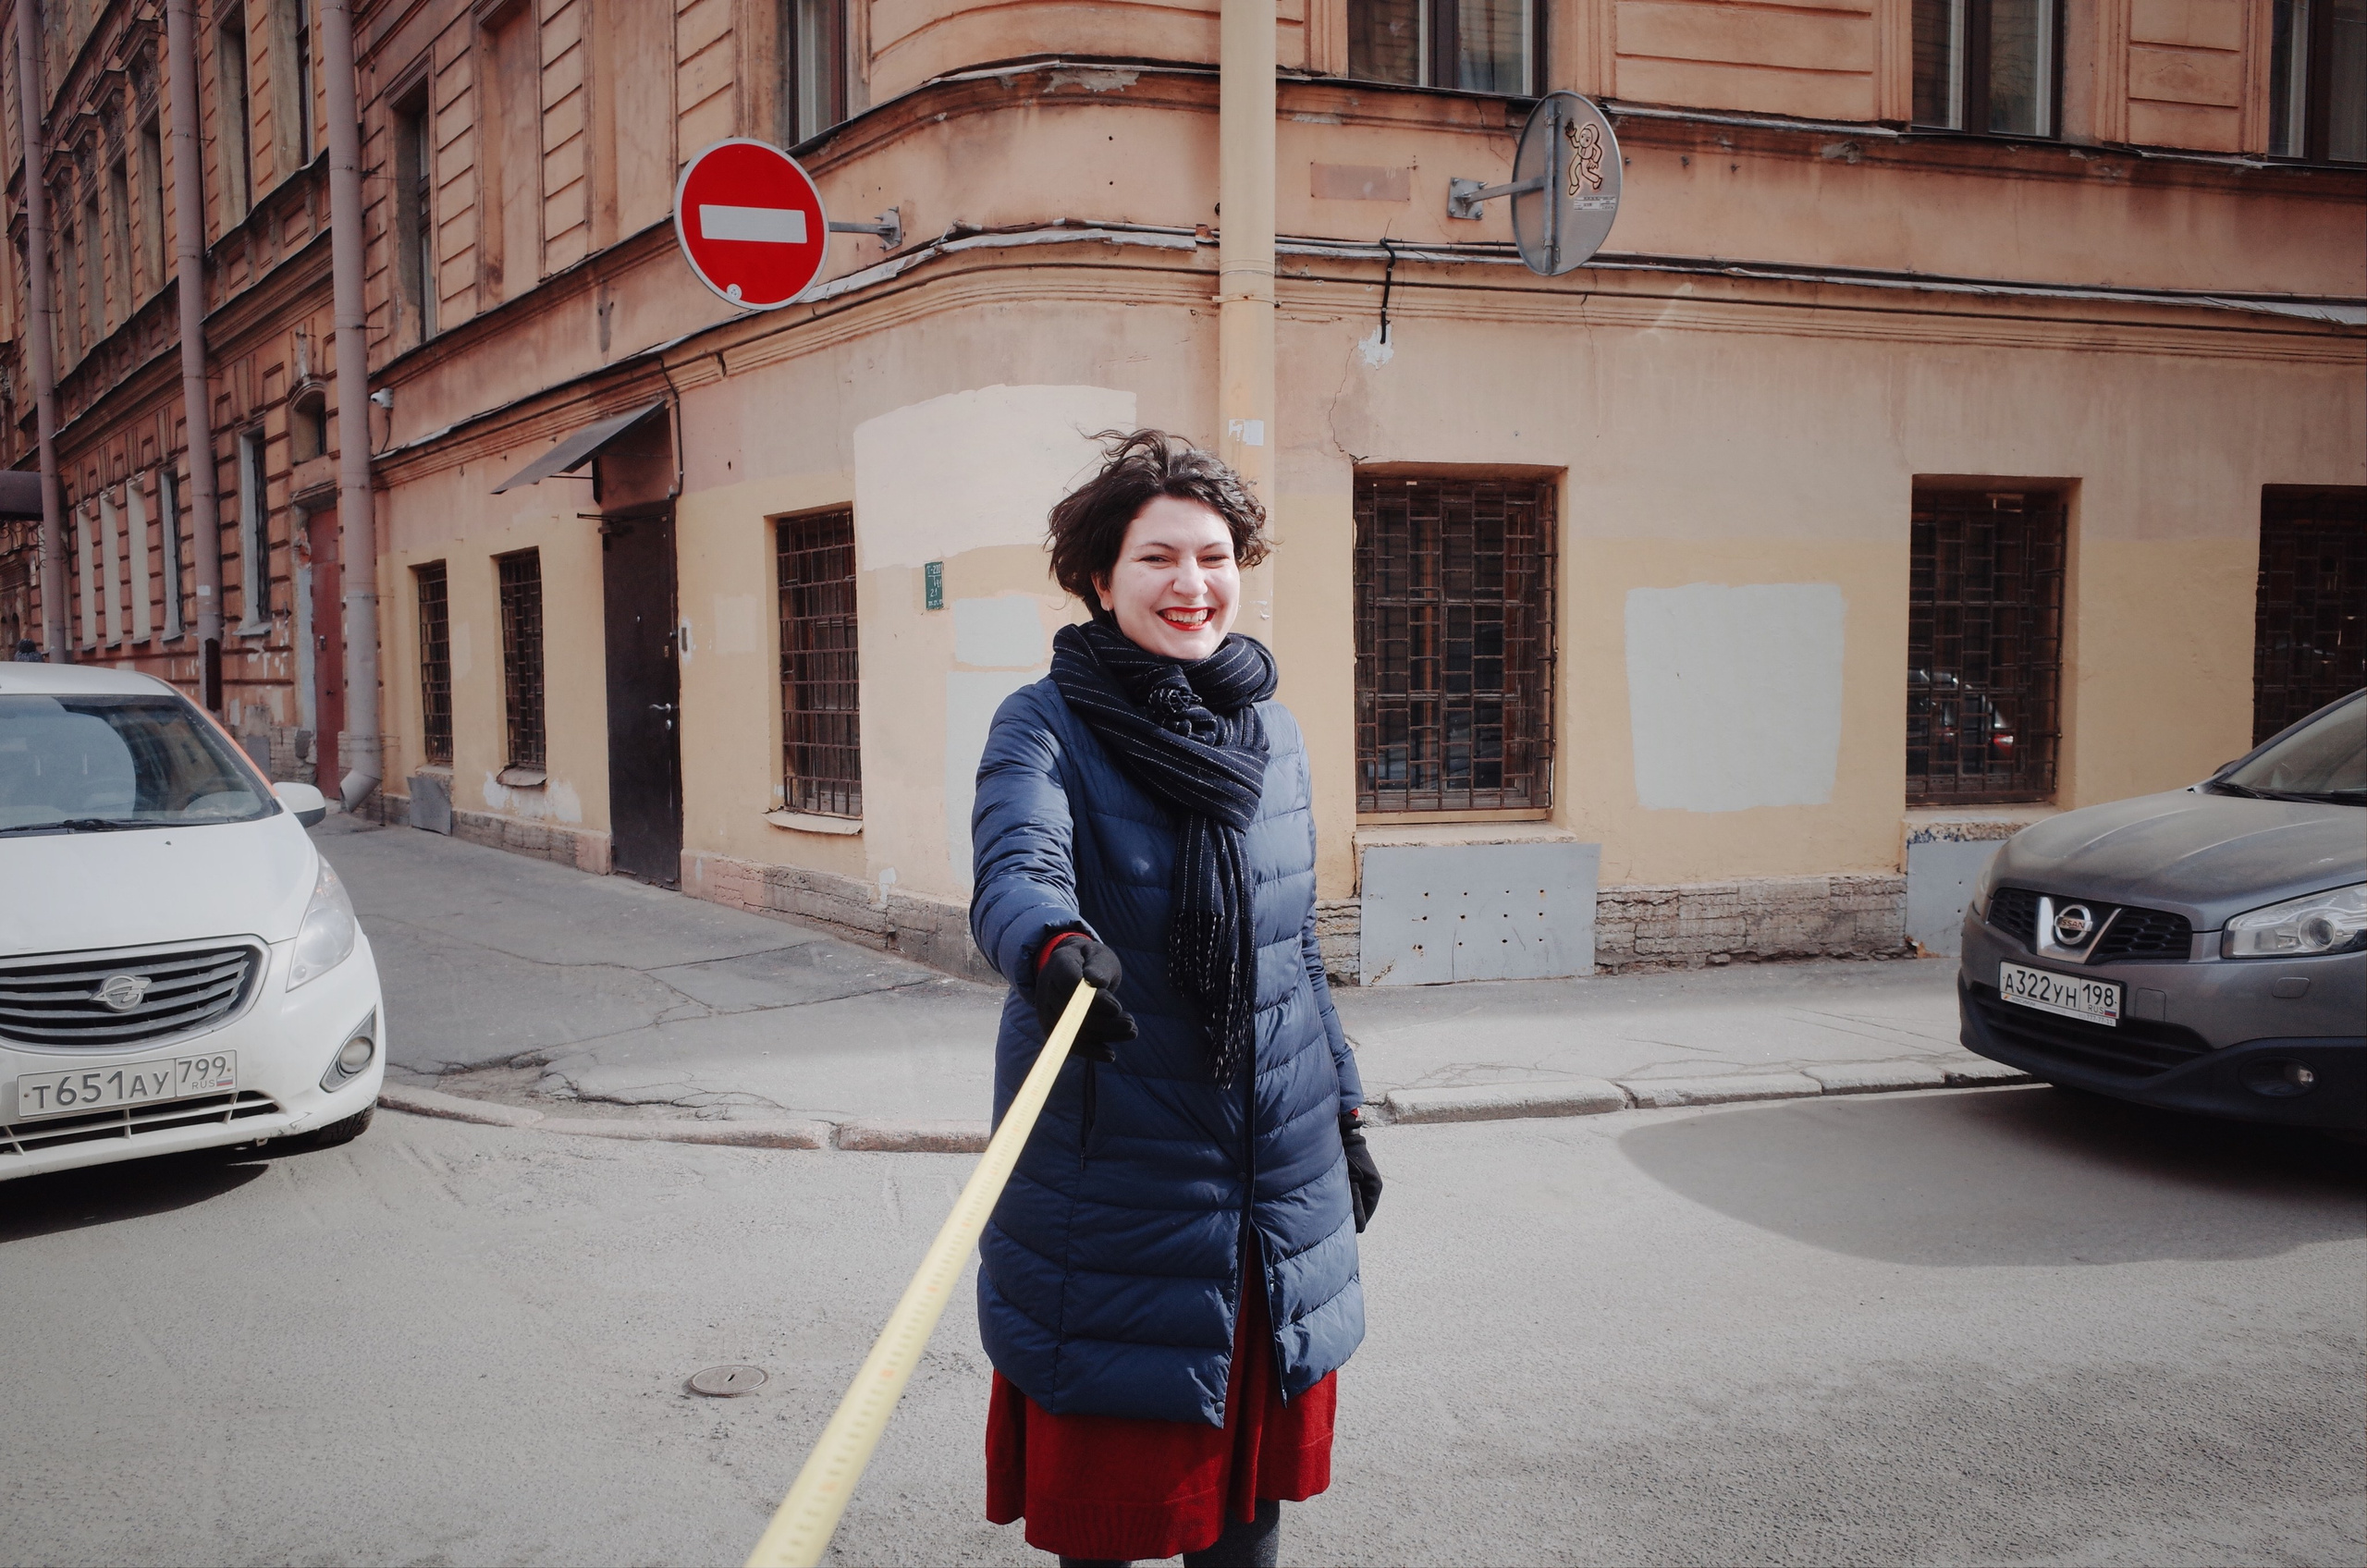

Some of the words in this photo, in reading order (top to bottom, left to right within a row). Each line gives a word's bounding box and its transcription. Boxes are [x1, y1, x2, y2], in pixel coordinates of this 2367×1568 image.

[2057, 917, 2084, 929] SSAN
[2005, 970, 2077, 1008] А322УН
[2082, 984, 2114, 1008] 198
[2088, 1004, 2103, 1015] RUS
[32, 1070, 169, 1109] Т651АУ
[178, 1056, 227, 1083] 799
[191, 1078, 215, 1090] RUS
